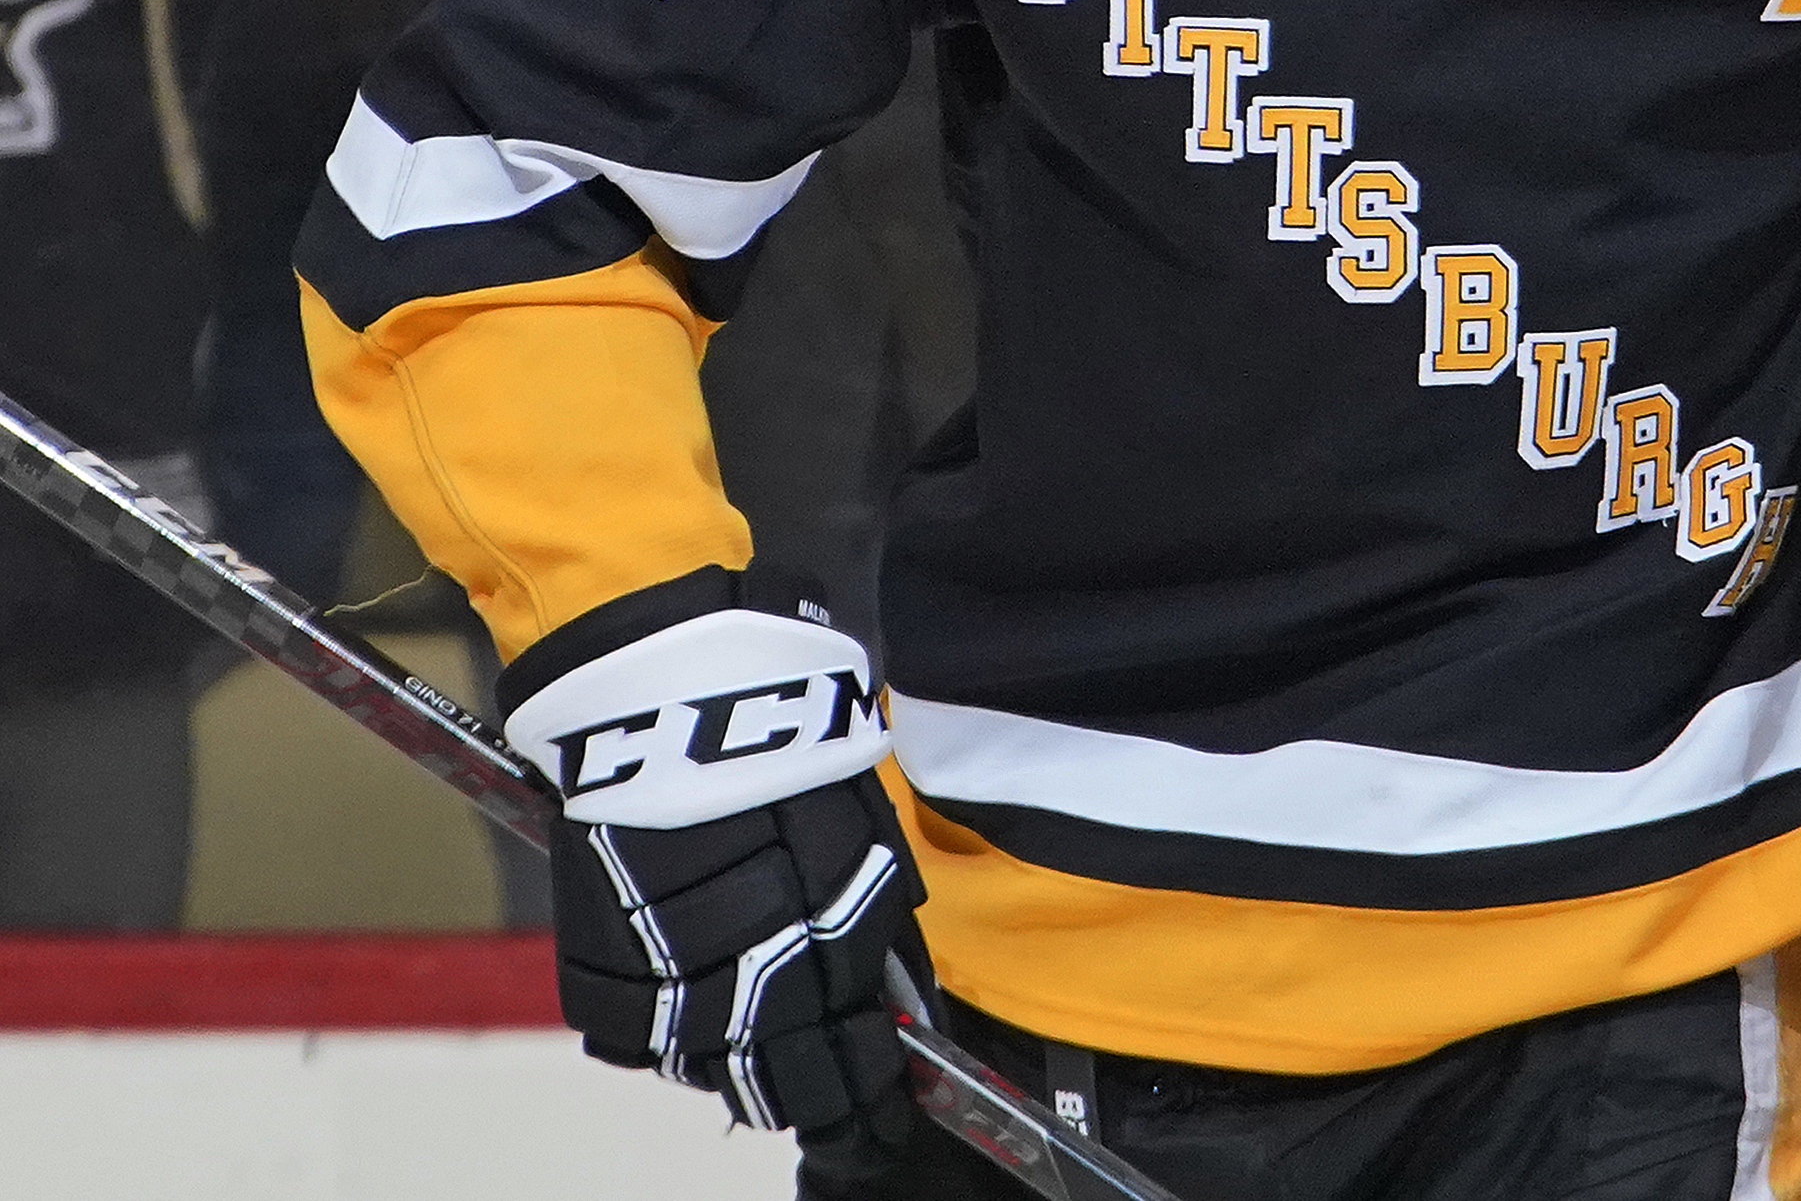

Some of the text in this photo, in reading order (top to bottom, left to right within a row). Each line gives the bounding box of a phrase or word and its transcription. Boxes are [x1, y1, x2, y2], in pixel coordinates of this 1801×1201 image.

[65, 449, 275, 586] CCM
[404, 675, 482, 733] GINO 71
[546, 669, 891, 801] CCM
